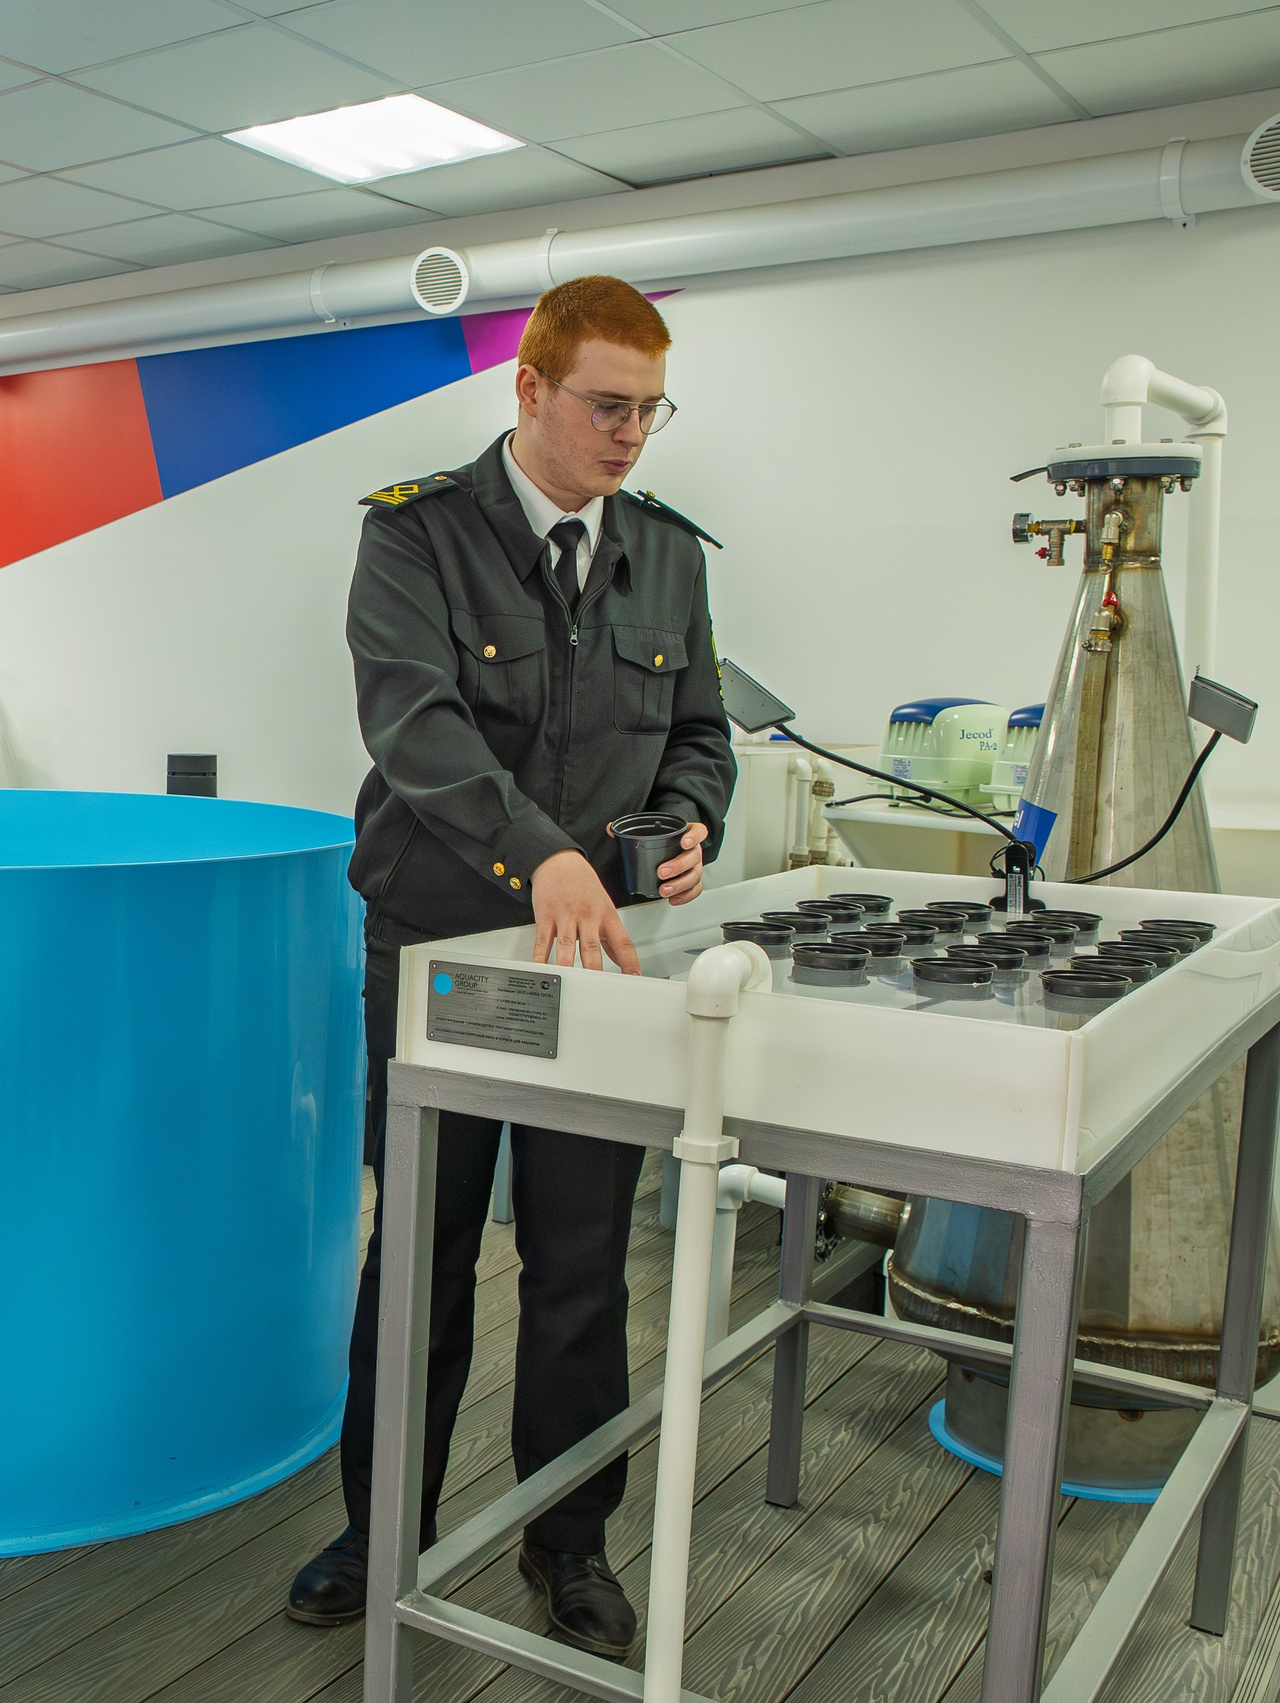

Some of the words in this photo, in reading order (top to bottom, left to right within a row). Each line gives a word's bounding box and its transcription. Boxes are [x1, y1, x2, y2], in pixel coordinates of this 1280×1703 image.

[959, 728, 992, 740] Jecod
[454, 973, 490, 983] AQUACITY
[454, 980, 478, 989] GROUP
